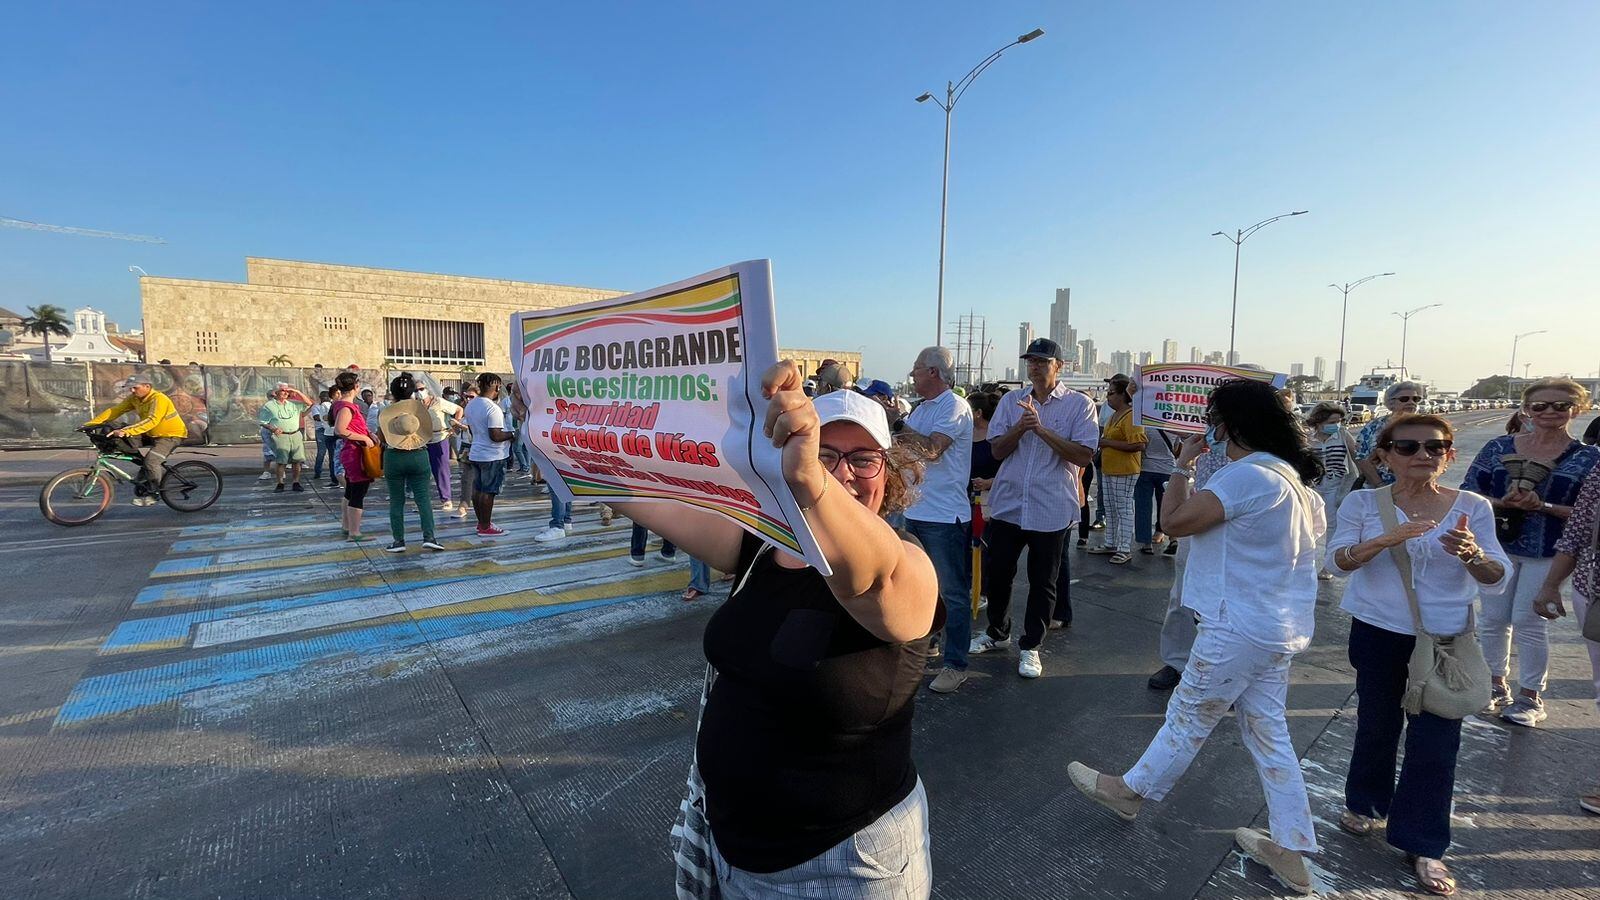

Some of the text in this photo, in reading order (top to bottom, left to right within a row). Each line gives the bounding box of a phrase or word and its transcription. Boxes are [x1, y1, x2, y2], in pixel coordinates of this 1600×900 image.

[531, 326, 742, 373] JAC BOCAGRANDE
[546, 372, 719, 401] Necesitamos:
[1149, 374, 1169, 382] JAC
[1153, 402, 1186, 412] JUSTA
[1162, 412, 1208, 424] CATAS
[621, 430, 653, 459] de
[655, 431, 720, 468] Vías
